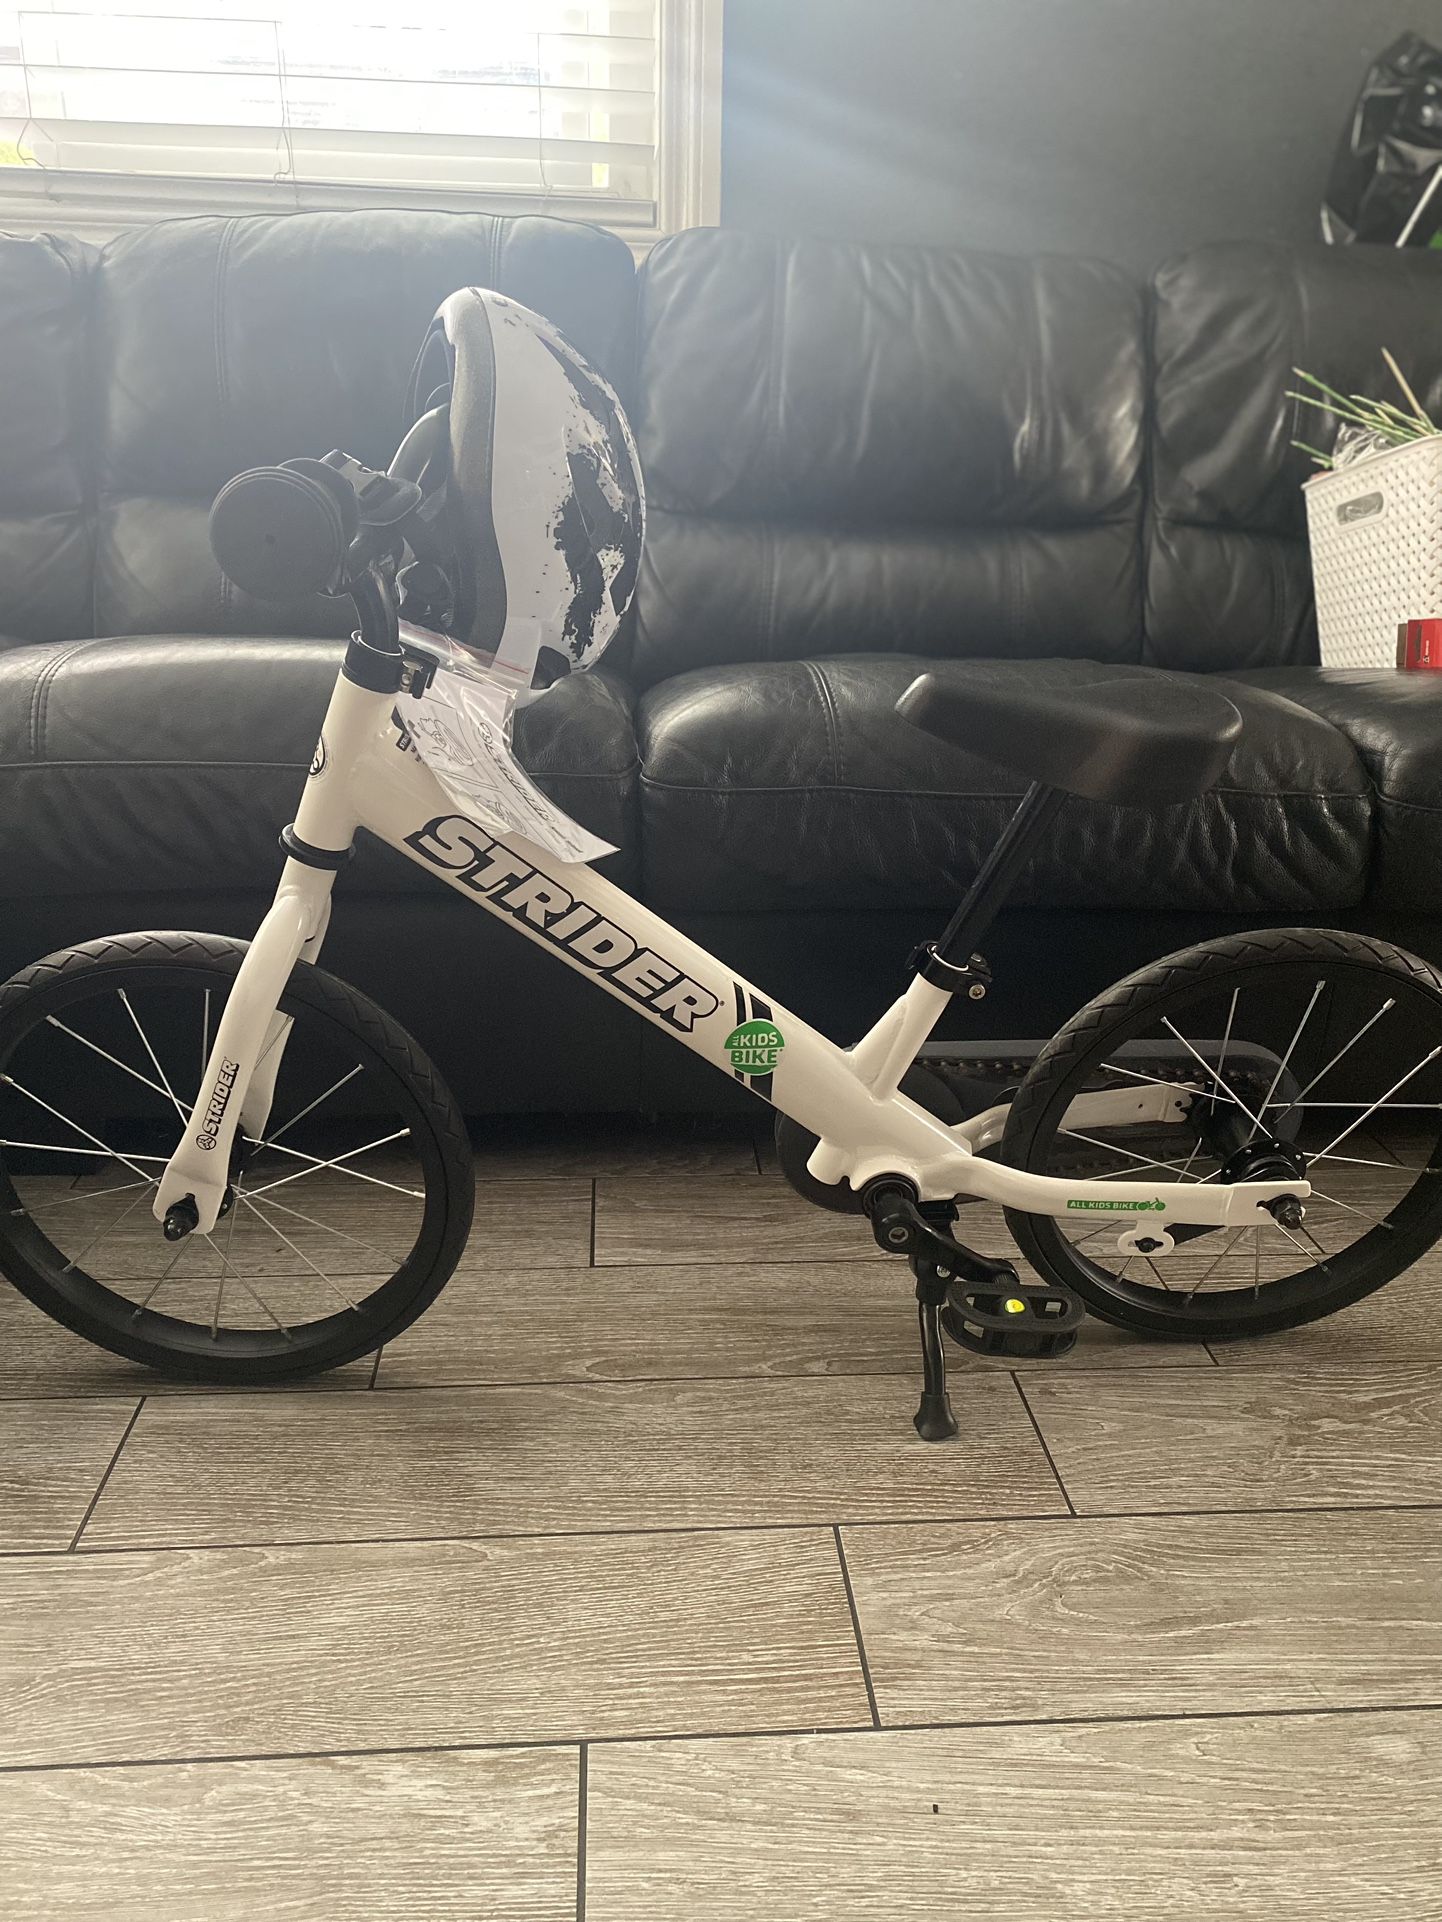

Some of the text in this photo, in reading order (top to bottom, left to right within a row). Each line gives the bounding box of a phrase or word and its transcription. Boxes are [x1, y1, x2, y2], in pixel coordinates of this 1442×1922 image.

[403, 814, 720, 1033] STRIDER
[740, 1032, 778, 1047] KIDS
[730, 1049, 778, 1064] BIKE
[201, 1059, 240, 1137] STRIDER
[1088, 1201, 1111, 1209] KIDS
[1113, 1202, 1135, 1210] BIKE
